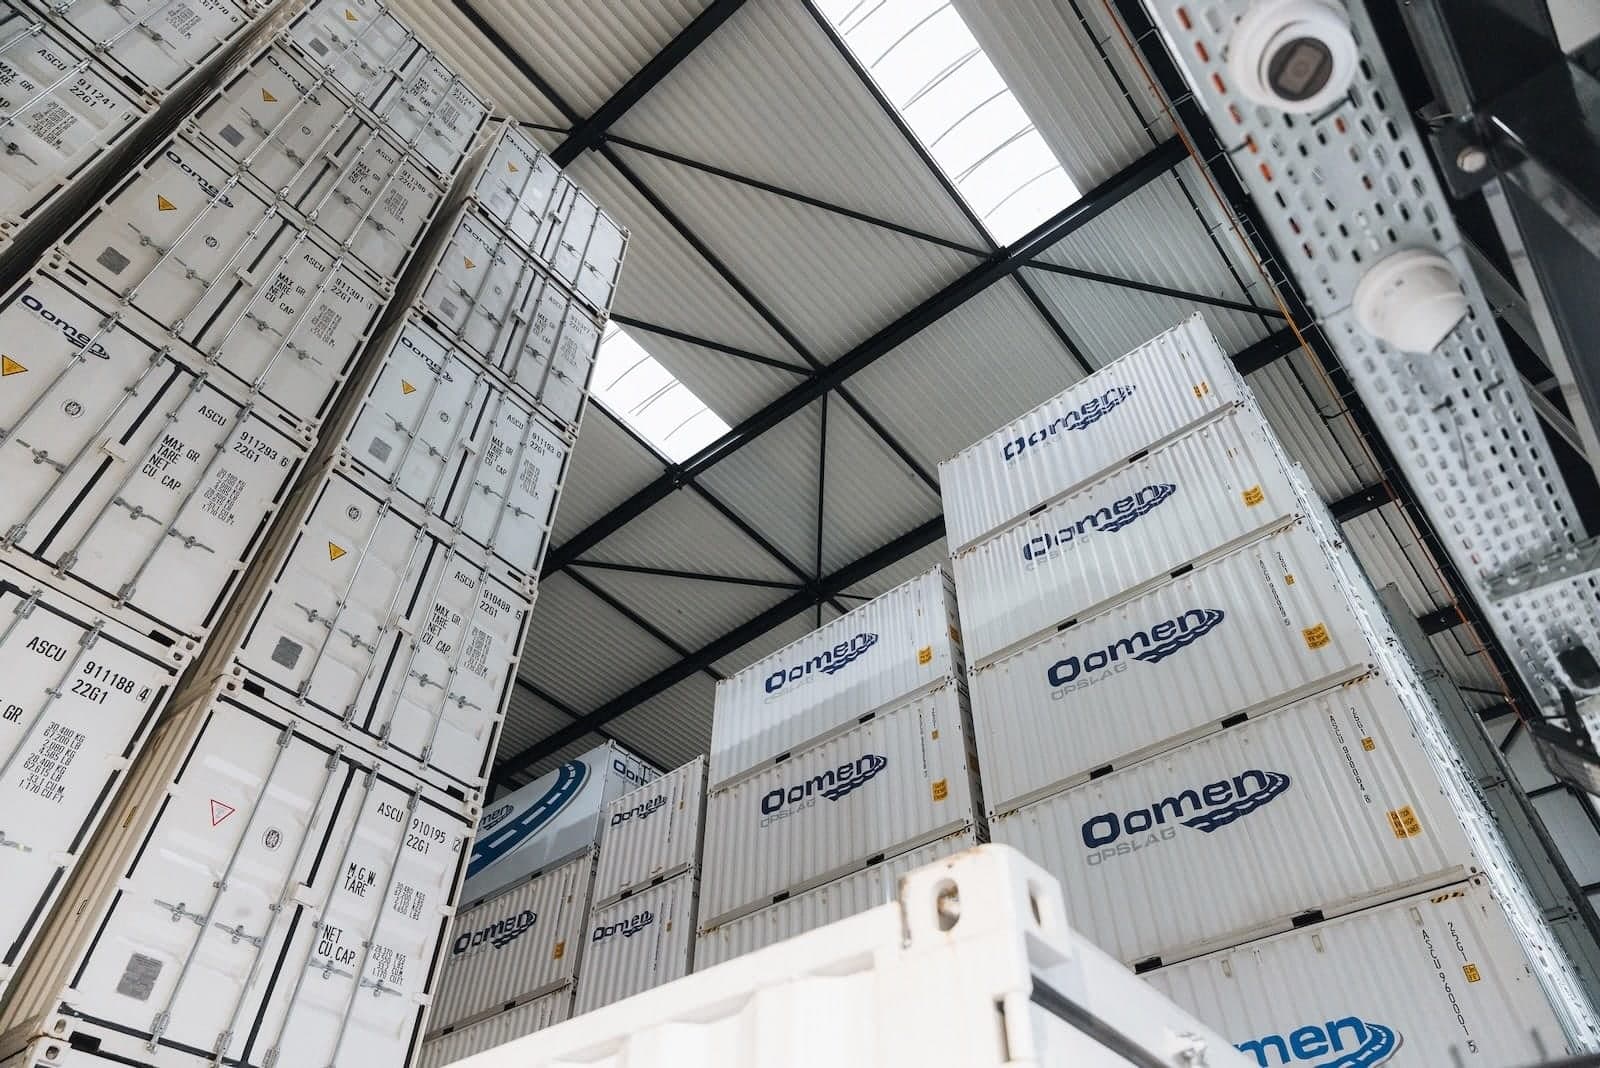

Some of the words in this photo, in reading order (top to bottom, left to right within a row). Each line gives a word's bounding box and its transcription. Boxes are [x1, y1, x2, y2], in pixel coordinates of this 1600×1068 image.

[37, 48, 67, 71] ASCU
[77, 78, 116, 109] 911241
[69, 85, 97, 107] 22G1
[304, 254, 326, 273] ASCU
[269, 285, 285, 299] NET
[275, 279, 292, 295] TARE
[331, 285, 351, 303] 22G1
[280, 302, 295, 315] CAP
[21, 295, 106, 354] Oomen
[1004, 388, 1126, 461] Oomen
[198, 405, 227, 426] ASCU
[240, 431, 278, 460] 911293
[281, 457, 289, 467] 6
[149, 454, 171, 471] NET
[157, 444, 181, 465] TARE
[233, 442, 260, 463] 22G1
[1023, 485, 1162, 560] Oomen
[454, 571, 475, 589] ASCU
[480, 600, 498, 618] 22G1
[427, 622, 442, 637] NET
[432, 612, 449, 629] TARE
[1048, 609, 1210, 687] Oomen
[26, 636, 67, 662] ASCU
[83, 661, 135, 694] 911188
[138, 687, 150, 702] 4
[765, 633, 868, 693] Oomen
[72, 679, 108, 704] 22G1
[1051, 662, 1128, 700] OPSLAG
[2, 704, 23, 725] GR.
[70, 741, 80, 750] LB
[75, 733, 85, 743] KG
[61, 756, 72, 766] LB
[65, 749, 76, 759] KG
[51, 772, 62, 783] LB
[56, 764, 67, 775] KG
[762, 755, 876, 815] Oomen
[611, 795, 664, 827] Oomen
[760, 799, 816, 828] OPSLAG
[1081, 770, 1269, 849] Oomen
[377, 802, 404, 822] ASCU
[412, 818, 446, 844] 910195
[406, 834, 429, 855] 22G1
[1087, 828, 1177, 867] OPSLAG
[344, 876, 368, 898] TARE
[323, 924, 343, 944] NET
[453, 911, 533, 955] Oomen
[593, 911, 650, 942] Oomen
[1447, 922, 1468, 962] 25G1
[1422, 929, 1441, 969] ASCU
[1439, 972, 1469, 1036] 960001
[1467, 1040, 1478, 1054] 5
[1233, 1016, 1368, 1068] men
